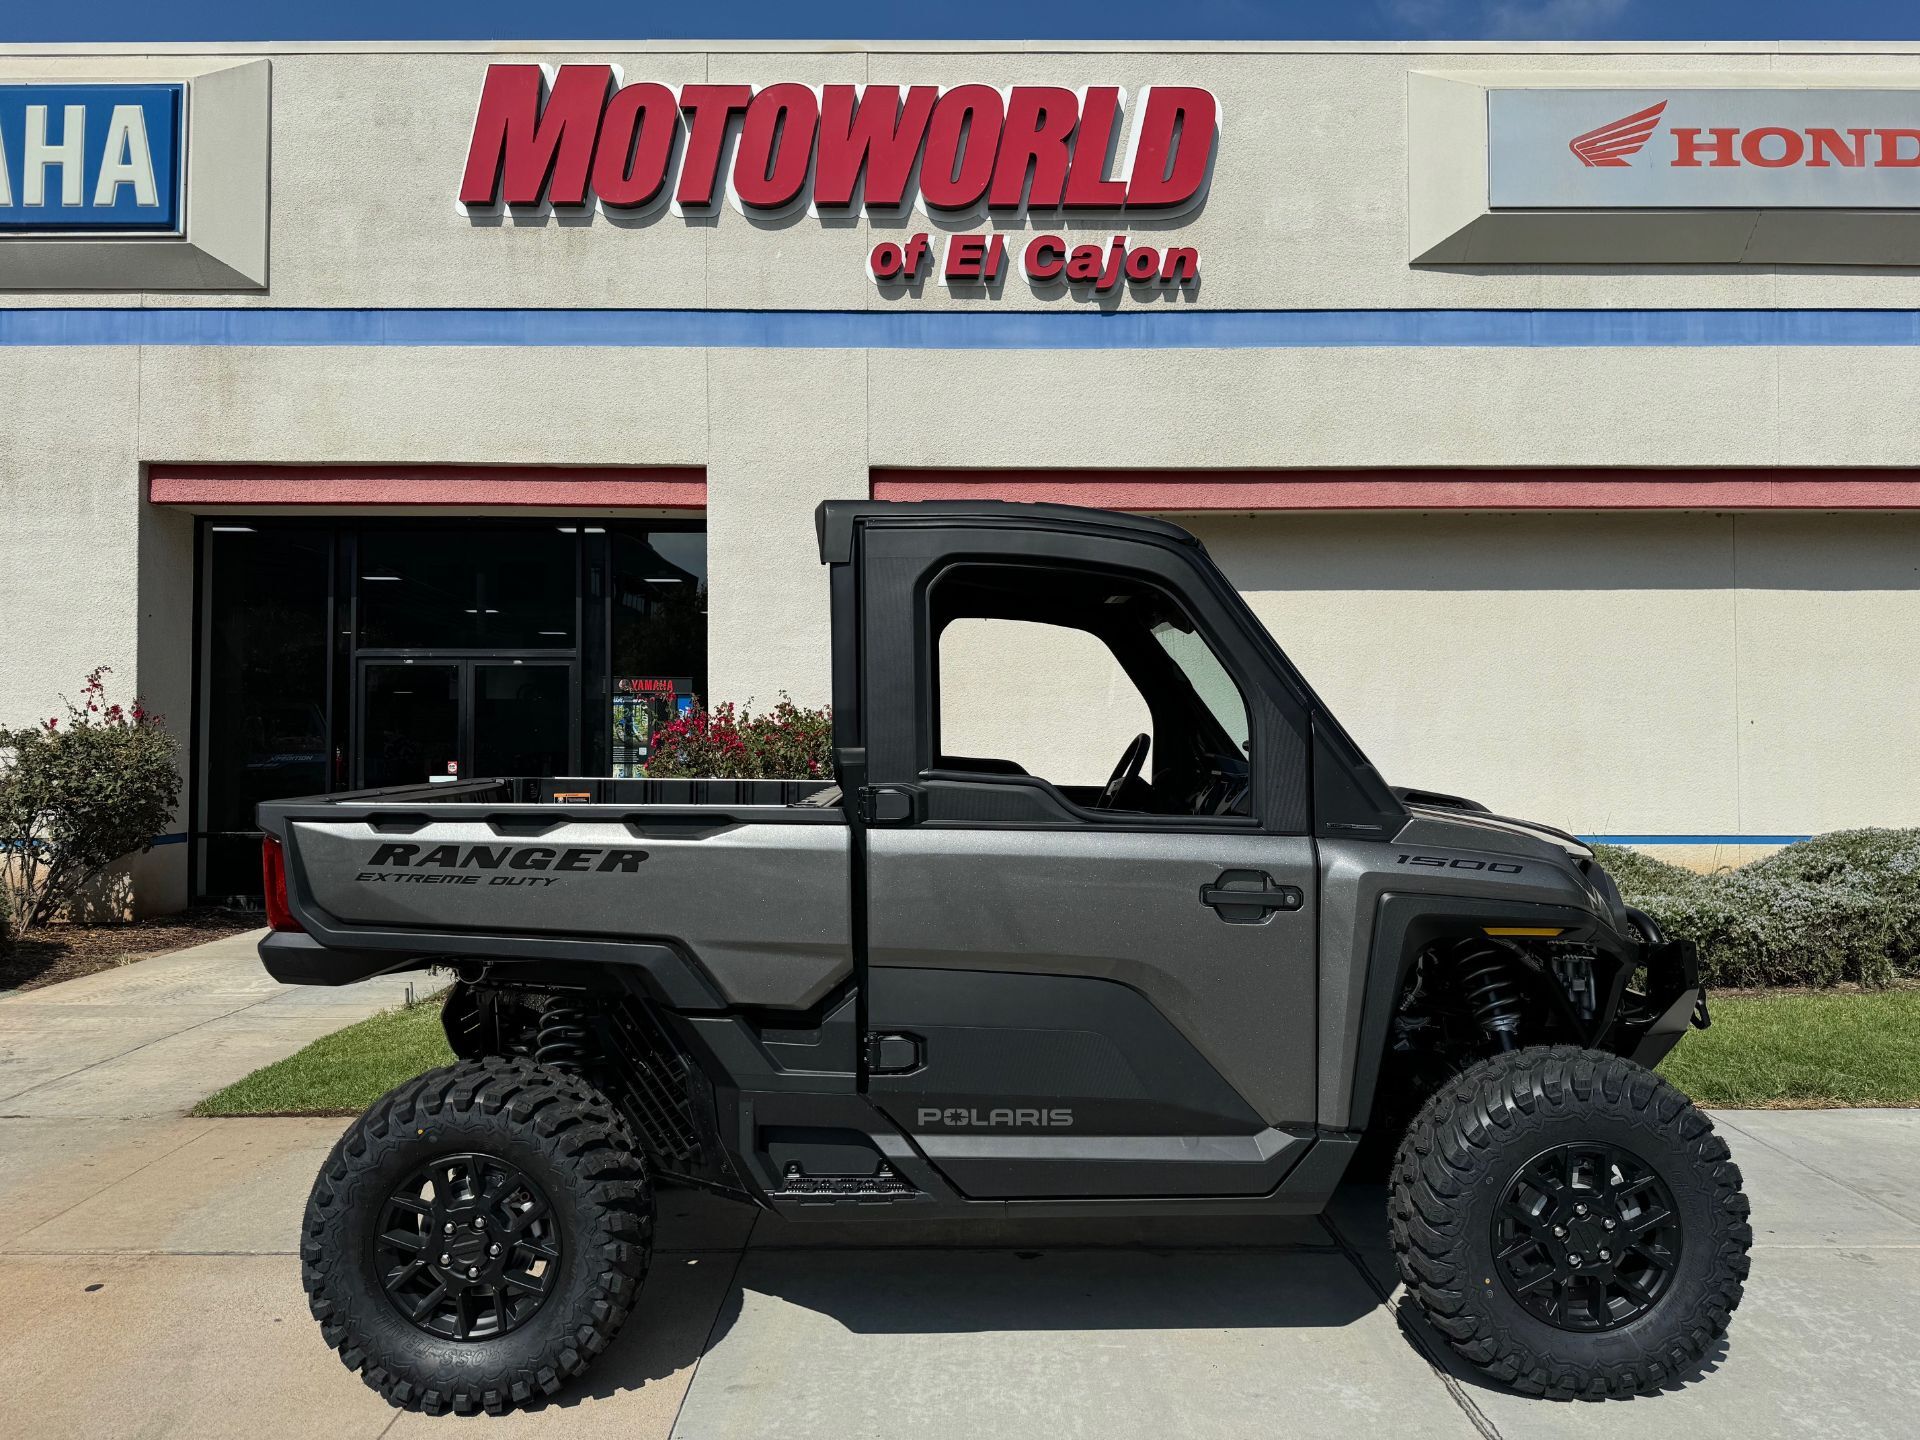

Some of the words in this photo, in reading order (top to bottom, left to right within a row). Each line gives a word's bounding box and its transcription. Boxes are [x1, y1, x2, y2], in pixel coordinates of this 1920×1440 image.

[0, 105, 159, 207] HA
[1670, 127, 1920, 168] HOND
[870, 233, 929, 279] of
[945, 234, 1004, 280] El
[1024, 234, 1199, 293] Cajon
[631, 679, 674, 691] YAMAHA
[367, 843, 650, 873] RANGER
[1397, 854, 1524, 874] 1500
[355, 872, 482, 885] EXTREME
[488, 876, 560, 887] DUTY
[917, 1108, 1074, 1126] POLARIS
